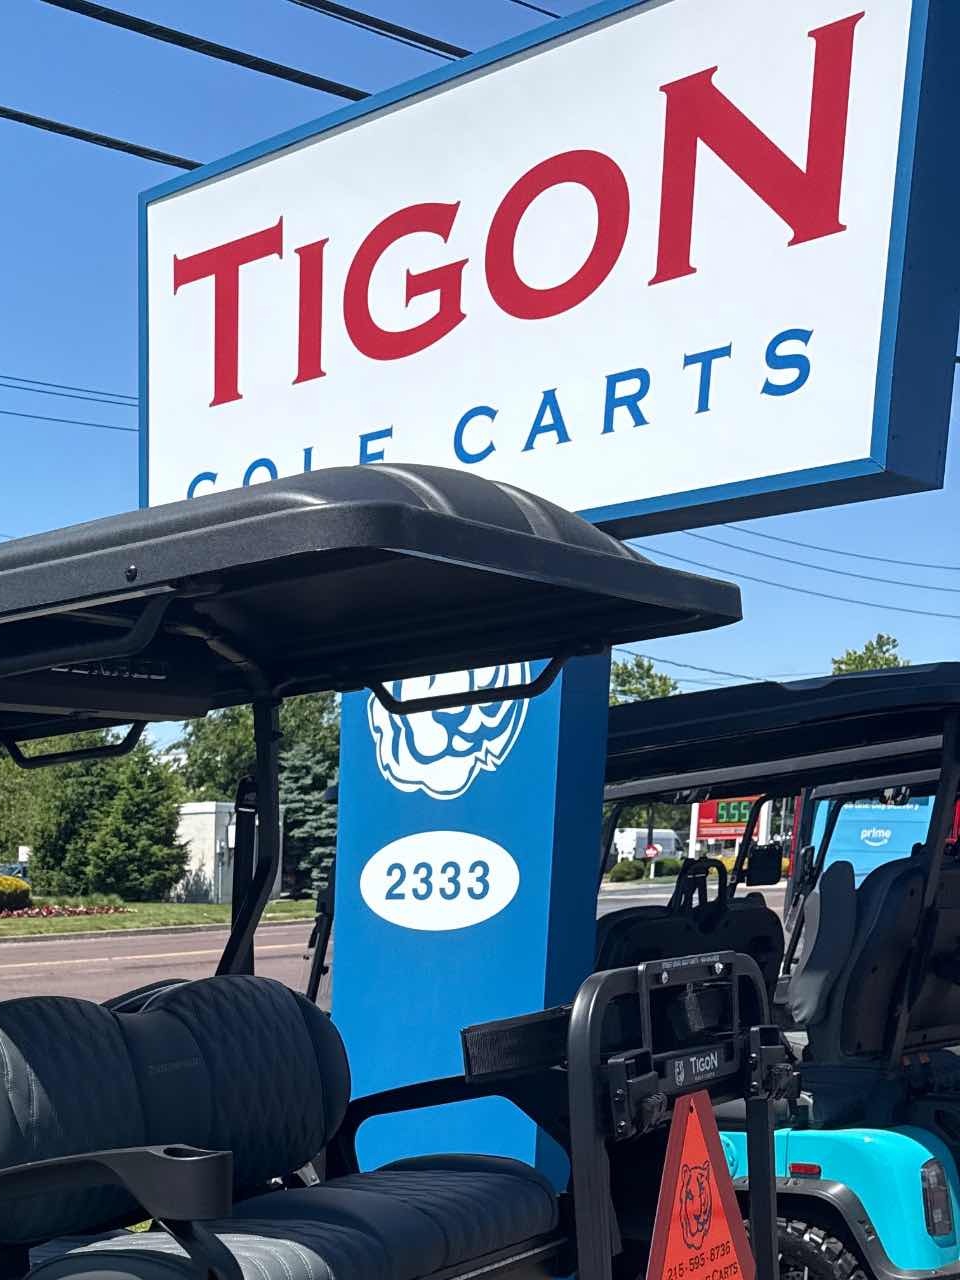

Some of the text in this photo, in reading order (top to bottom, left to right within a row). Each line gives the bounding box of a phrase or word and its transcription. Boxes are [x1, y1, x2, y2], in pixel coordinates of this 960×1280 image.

[173, 11, 865, 406] TIGON
[452, 328, 814, 464] CARTS
[860, 828, 892, 841] prime
[385, 860, 490, 901] 2333
[689, 1051, 718, 1075] TIGON
